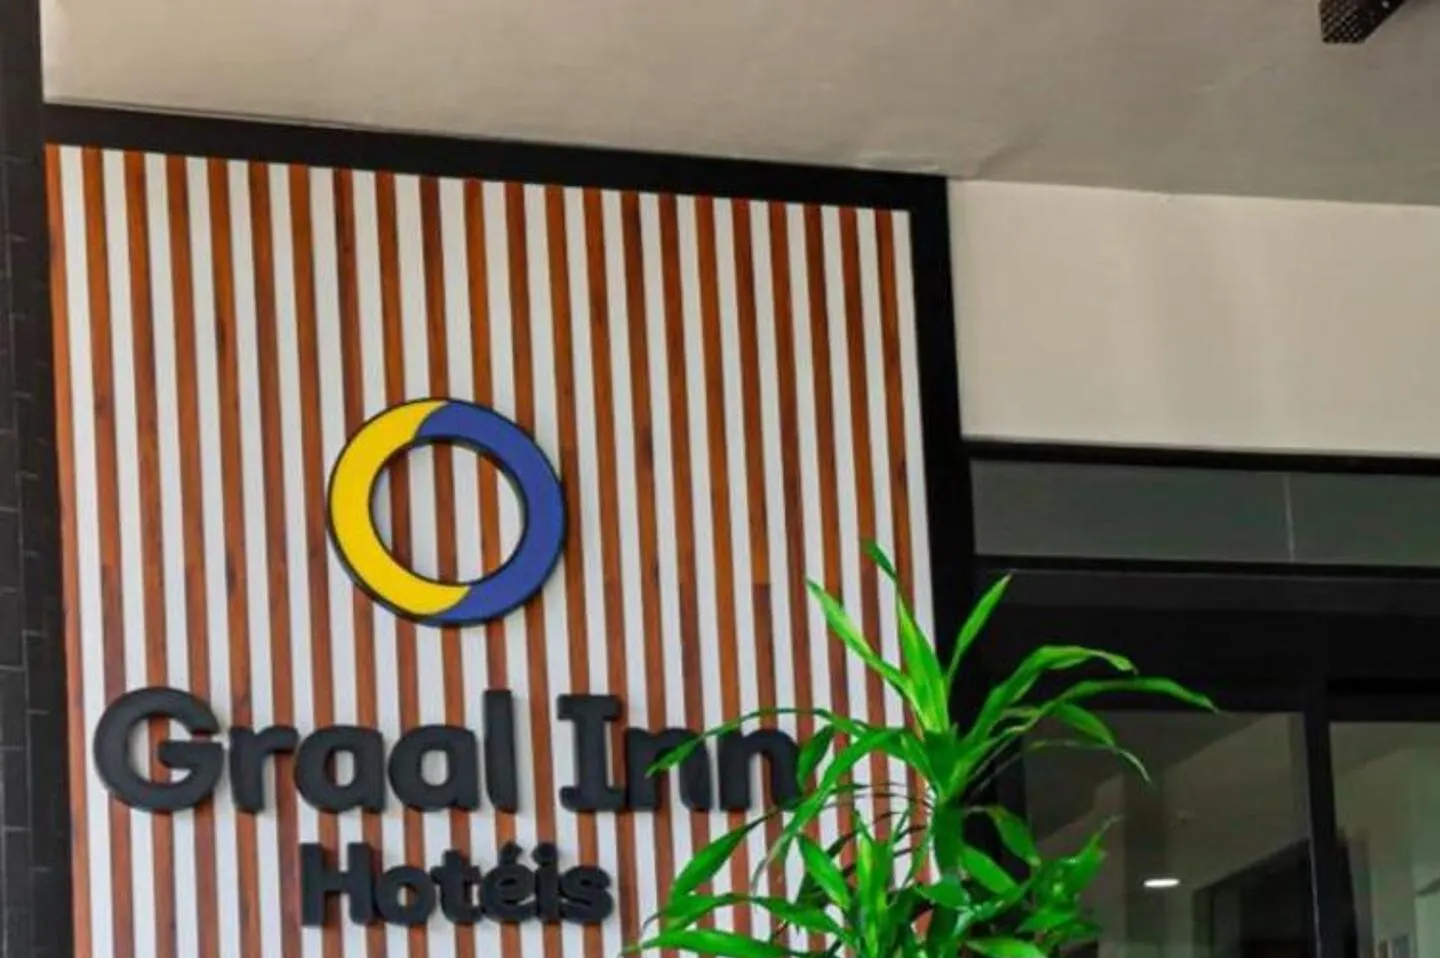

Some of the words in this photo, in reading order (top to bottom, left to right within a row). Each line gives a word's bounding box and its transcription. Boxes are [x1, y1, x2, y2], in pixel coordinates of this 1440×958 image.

[93, 686, 518, 814] Graal
[556, 694, 806, 812] Inn
[299, 842, 615, 927] Hotéis
